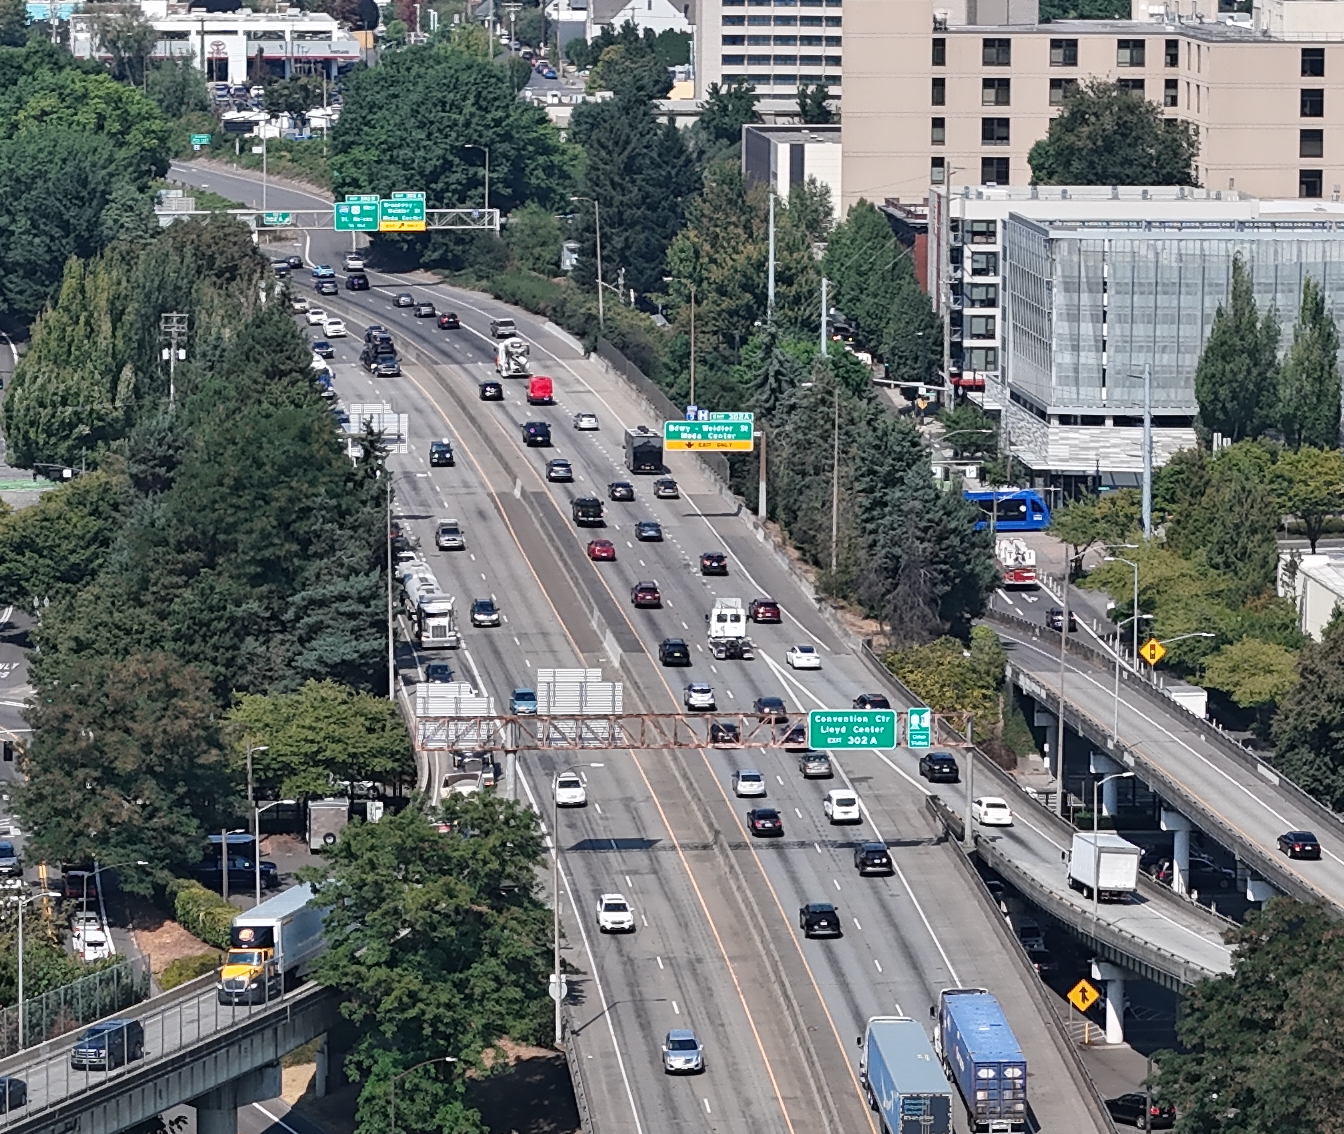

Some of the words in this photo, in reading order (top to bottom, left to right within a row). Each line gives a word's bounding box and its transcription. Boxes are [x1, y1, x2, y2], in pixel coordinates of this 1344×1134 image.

[814, 714, 869, 723] Convention
[875, 714, 891, 723] Ctr
[820, 725, 847, 735] Lloyd
[852, 725, 885, 734] Center
